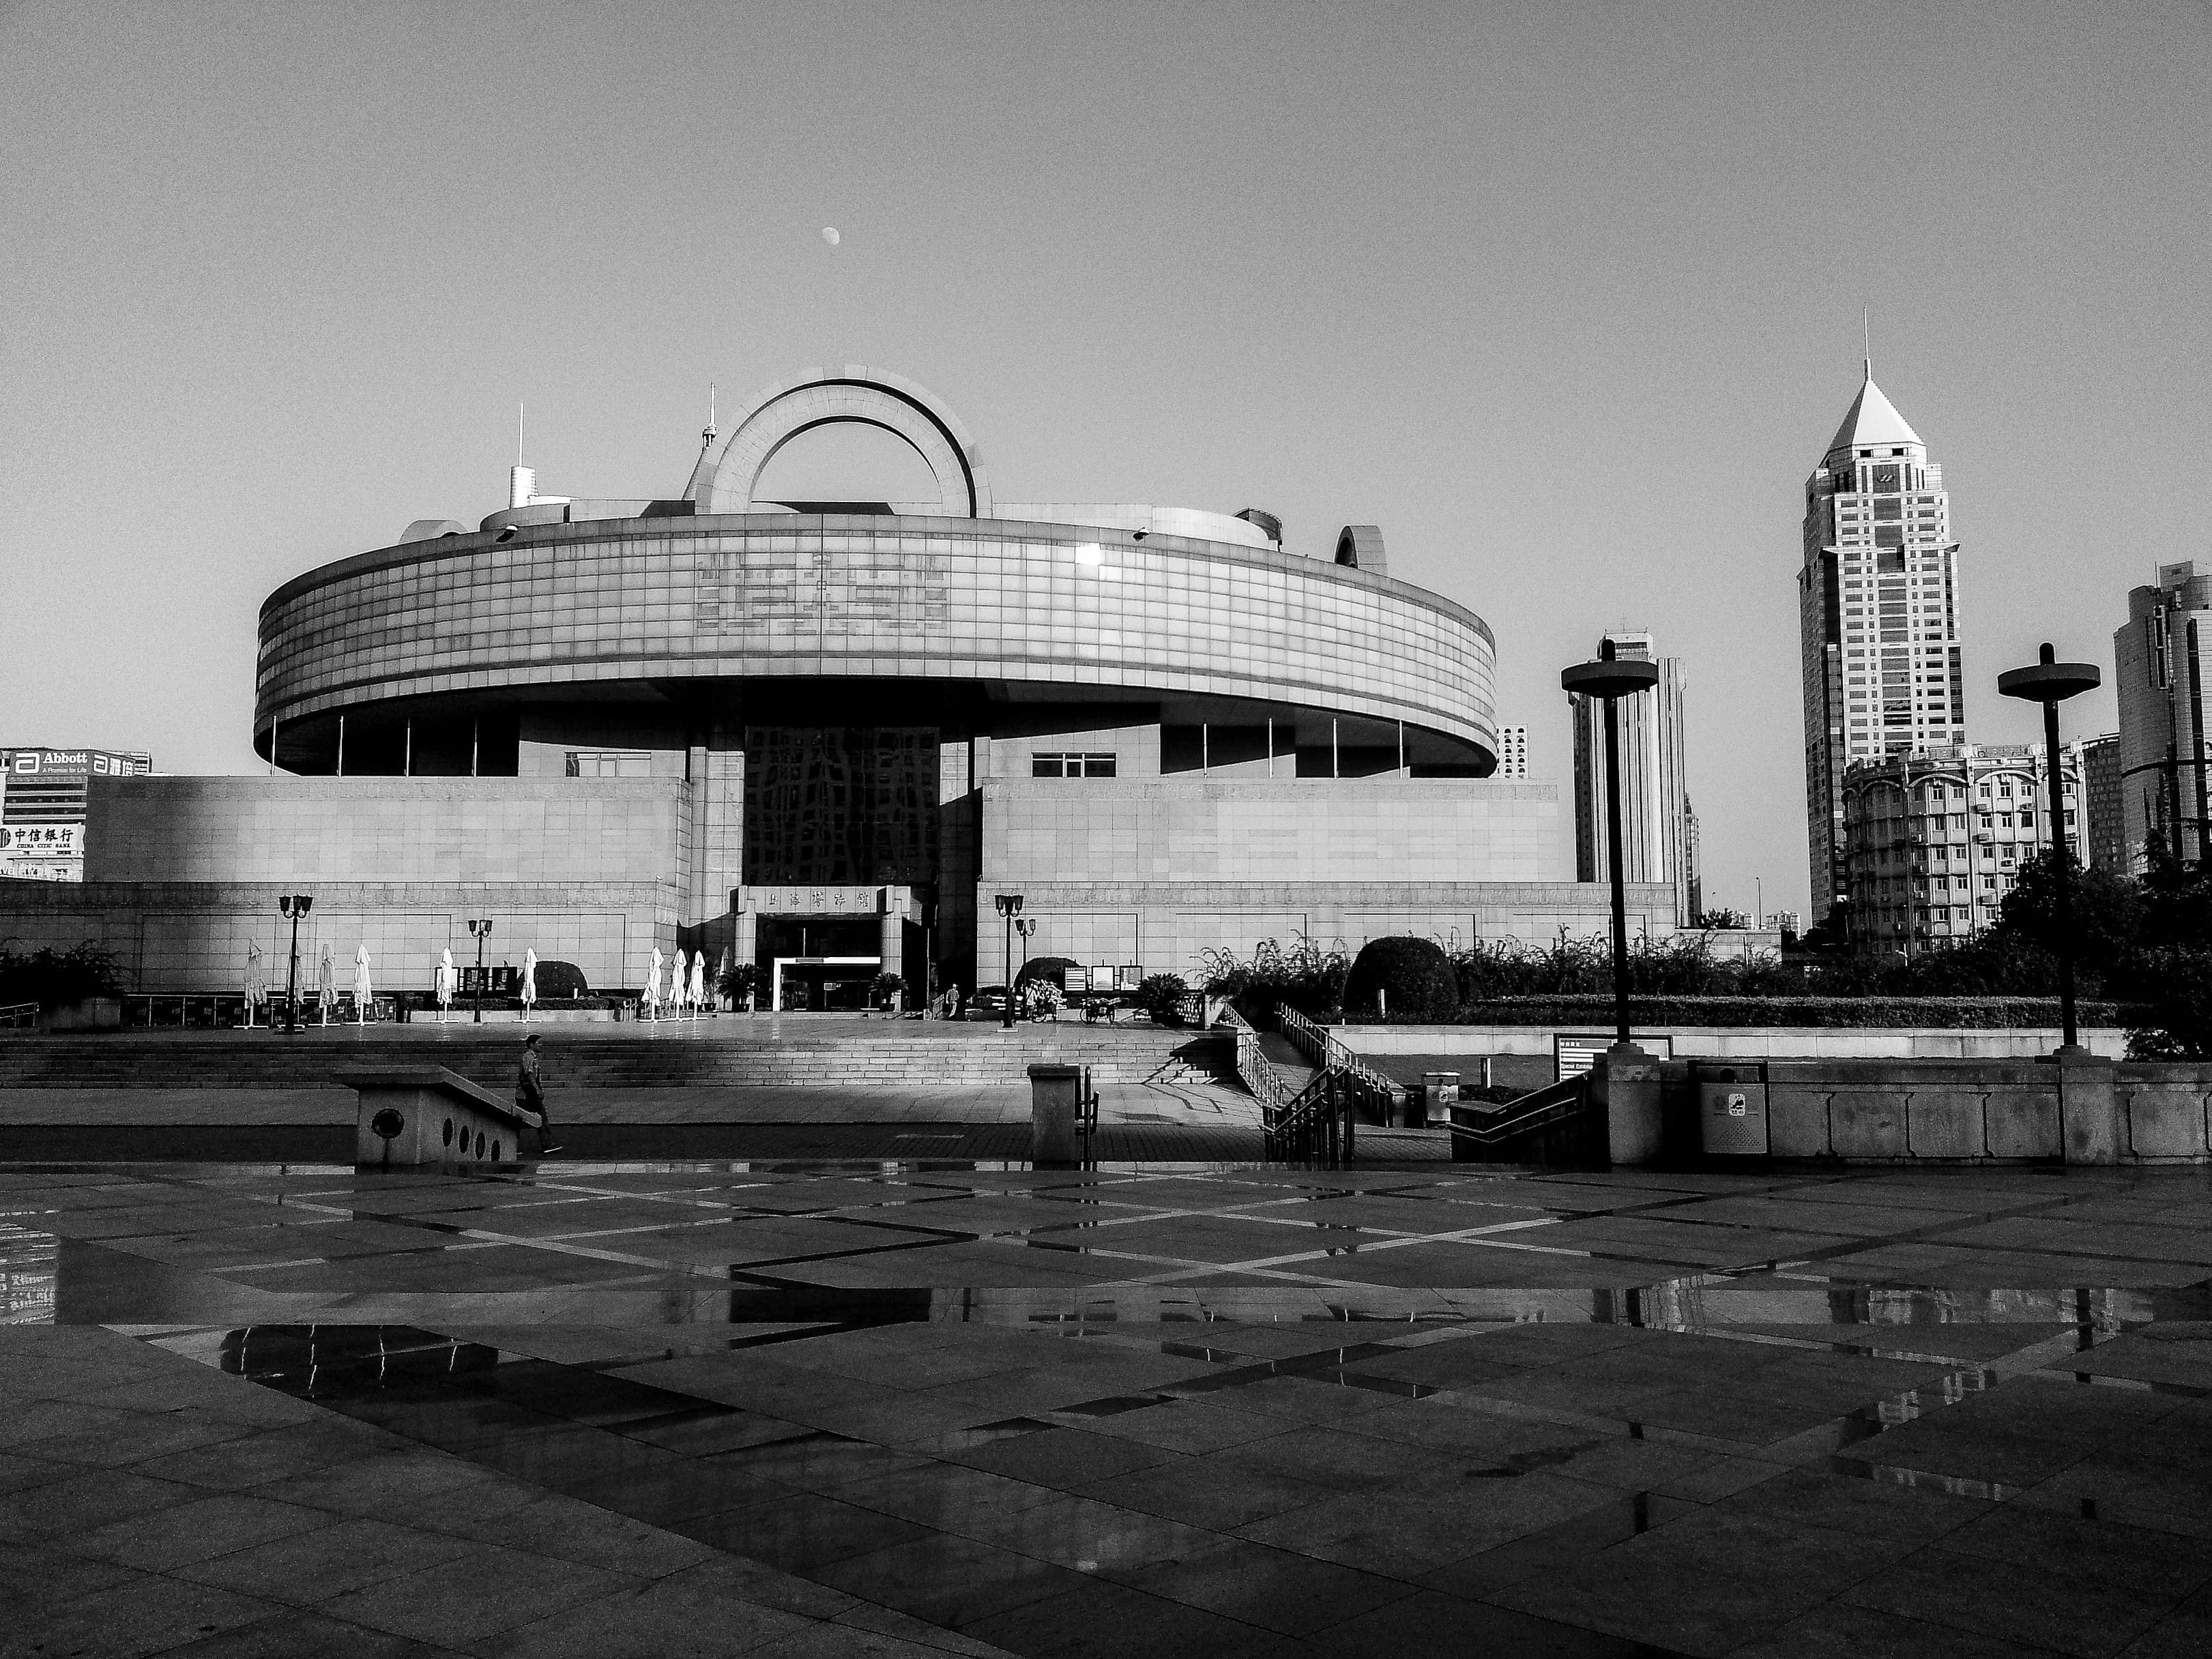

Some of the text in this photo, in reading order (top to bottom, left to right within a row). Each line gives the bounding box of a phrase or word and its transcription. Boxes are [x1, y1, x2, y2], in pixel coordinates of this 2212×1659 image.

[42, 753, 88, 764] Abbott
[15, 828, 74, 842] 中信银行
